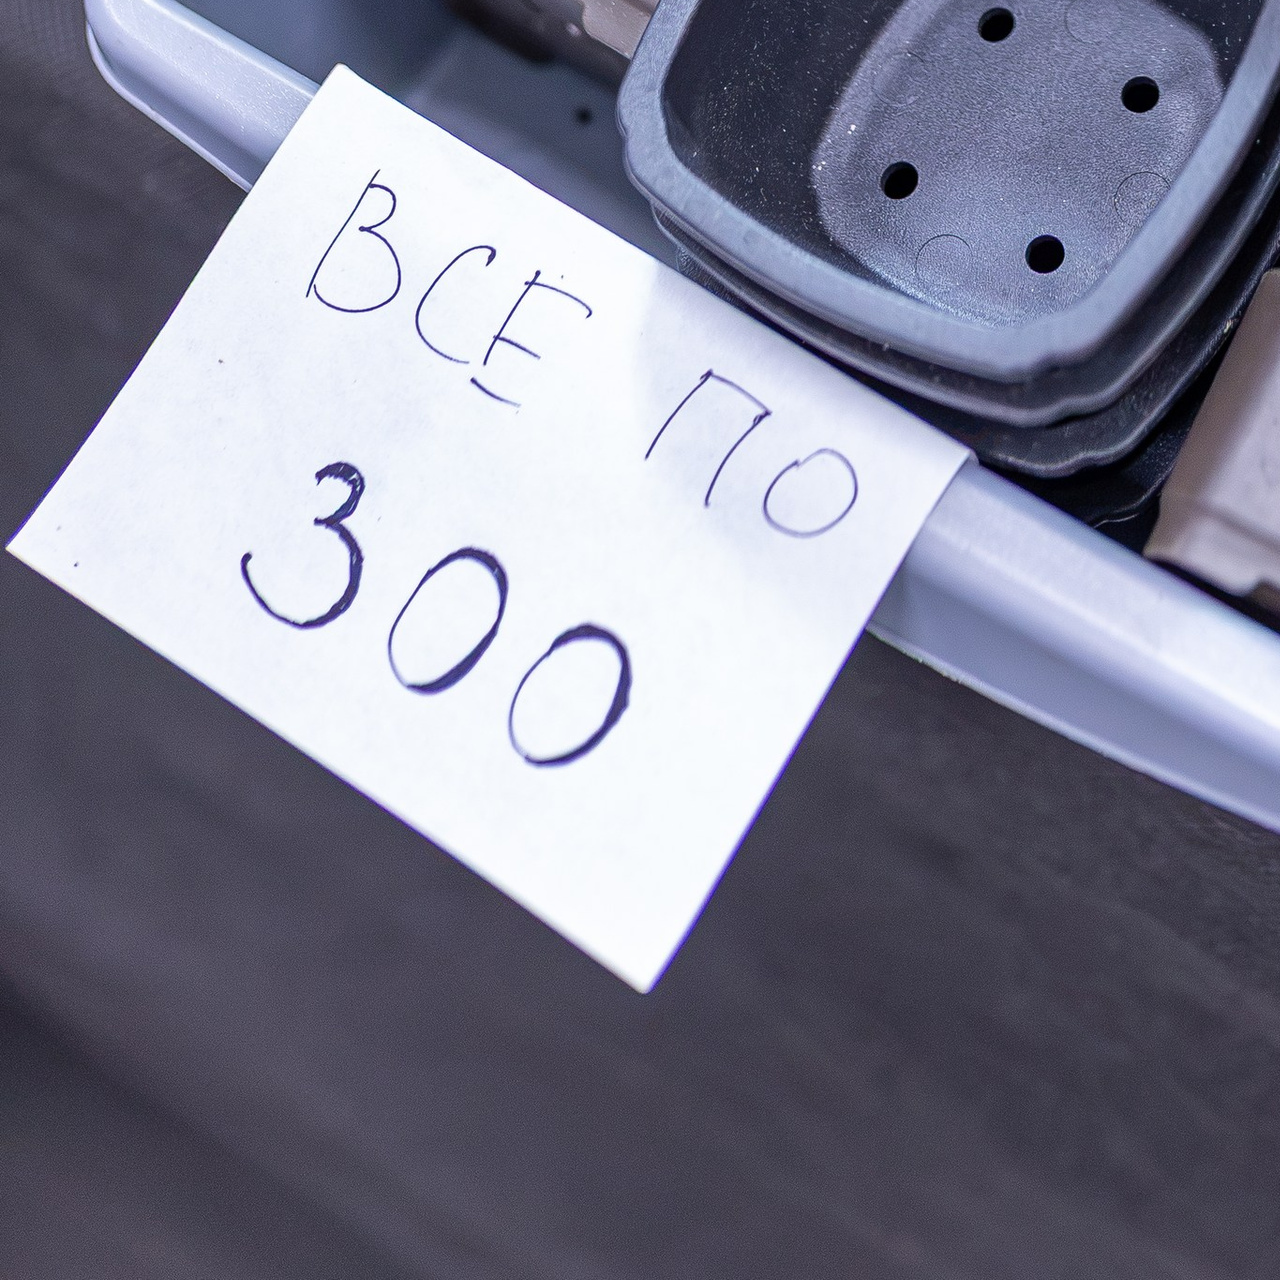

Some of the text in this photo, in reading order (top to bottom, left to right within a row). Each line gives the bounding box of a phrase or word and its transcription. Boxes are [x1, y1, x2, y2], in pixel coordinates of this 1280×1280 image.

[306, 169, 859, 538] ВСЕ ПО
[241, 461, 632, 768] 300
